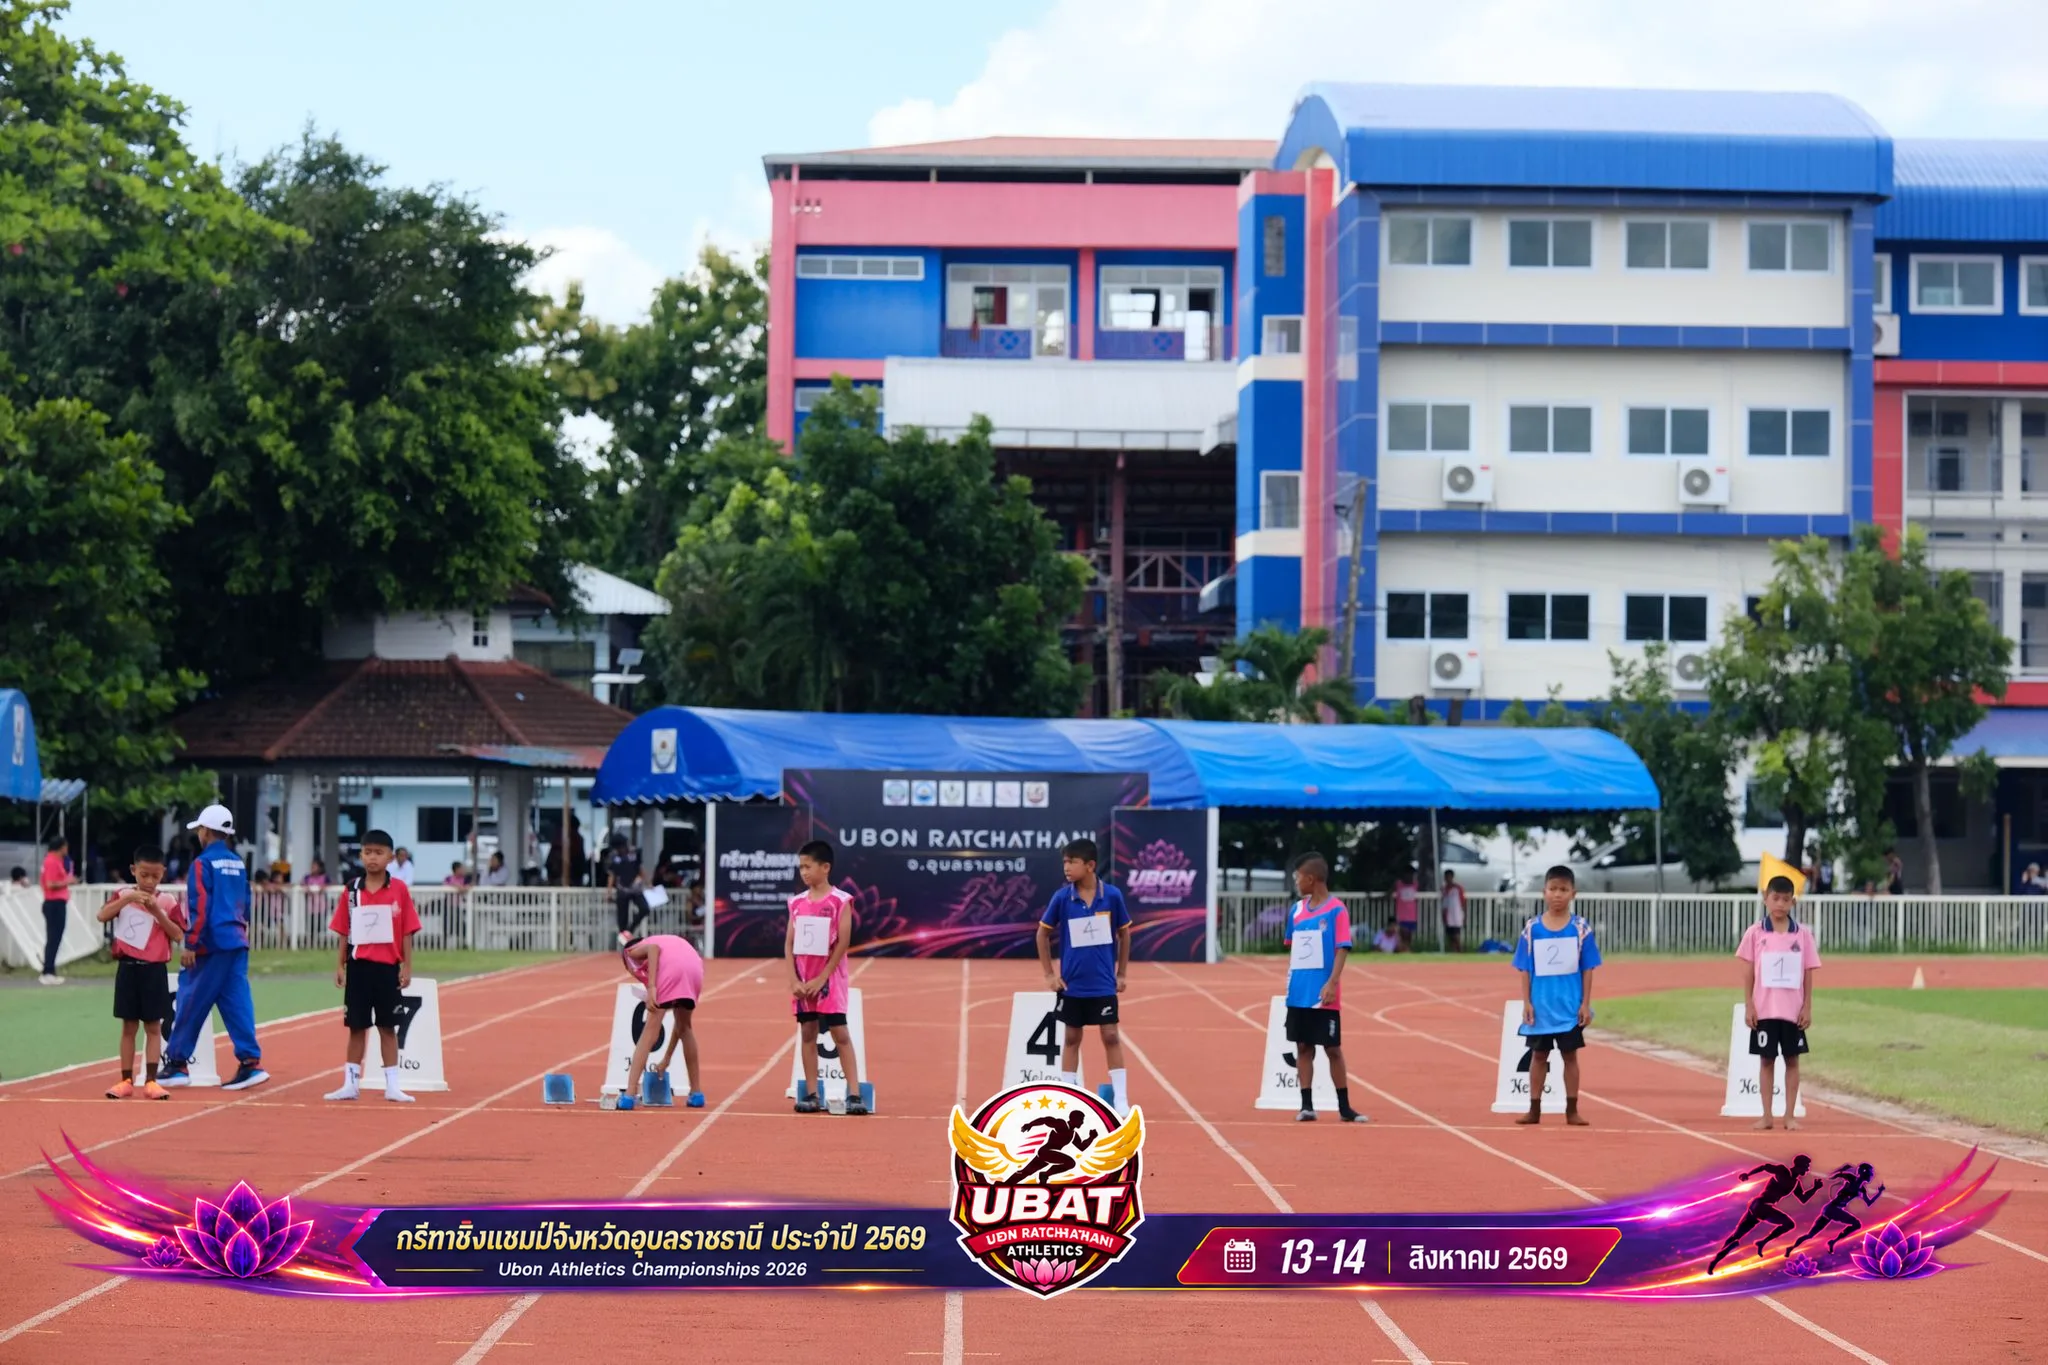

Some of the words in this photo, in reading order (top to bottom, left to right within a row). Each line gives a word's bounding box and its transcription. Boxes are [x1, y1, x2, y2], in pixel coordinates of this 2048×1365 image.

[839, 828, 918, 847] UBON
[1127, 869, 1197, 887] UBON
[123, 912, 146, 941] 8
[361, 912, 379, 937] 7
[803, 923, 815, 948] 5
[1083, 920, 1100, 940] 4
[1299, 936, 1313, 960] 3
[1547, 944, 1564, 965] 2
[1772, 957, 1791, 981] 1
[397, 996, 422, 1050] 7
[1026, 1012, 1061, 1066] 4
